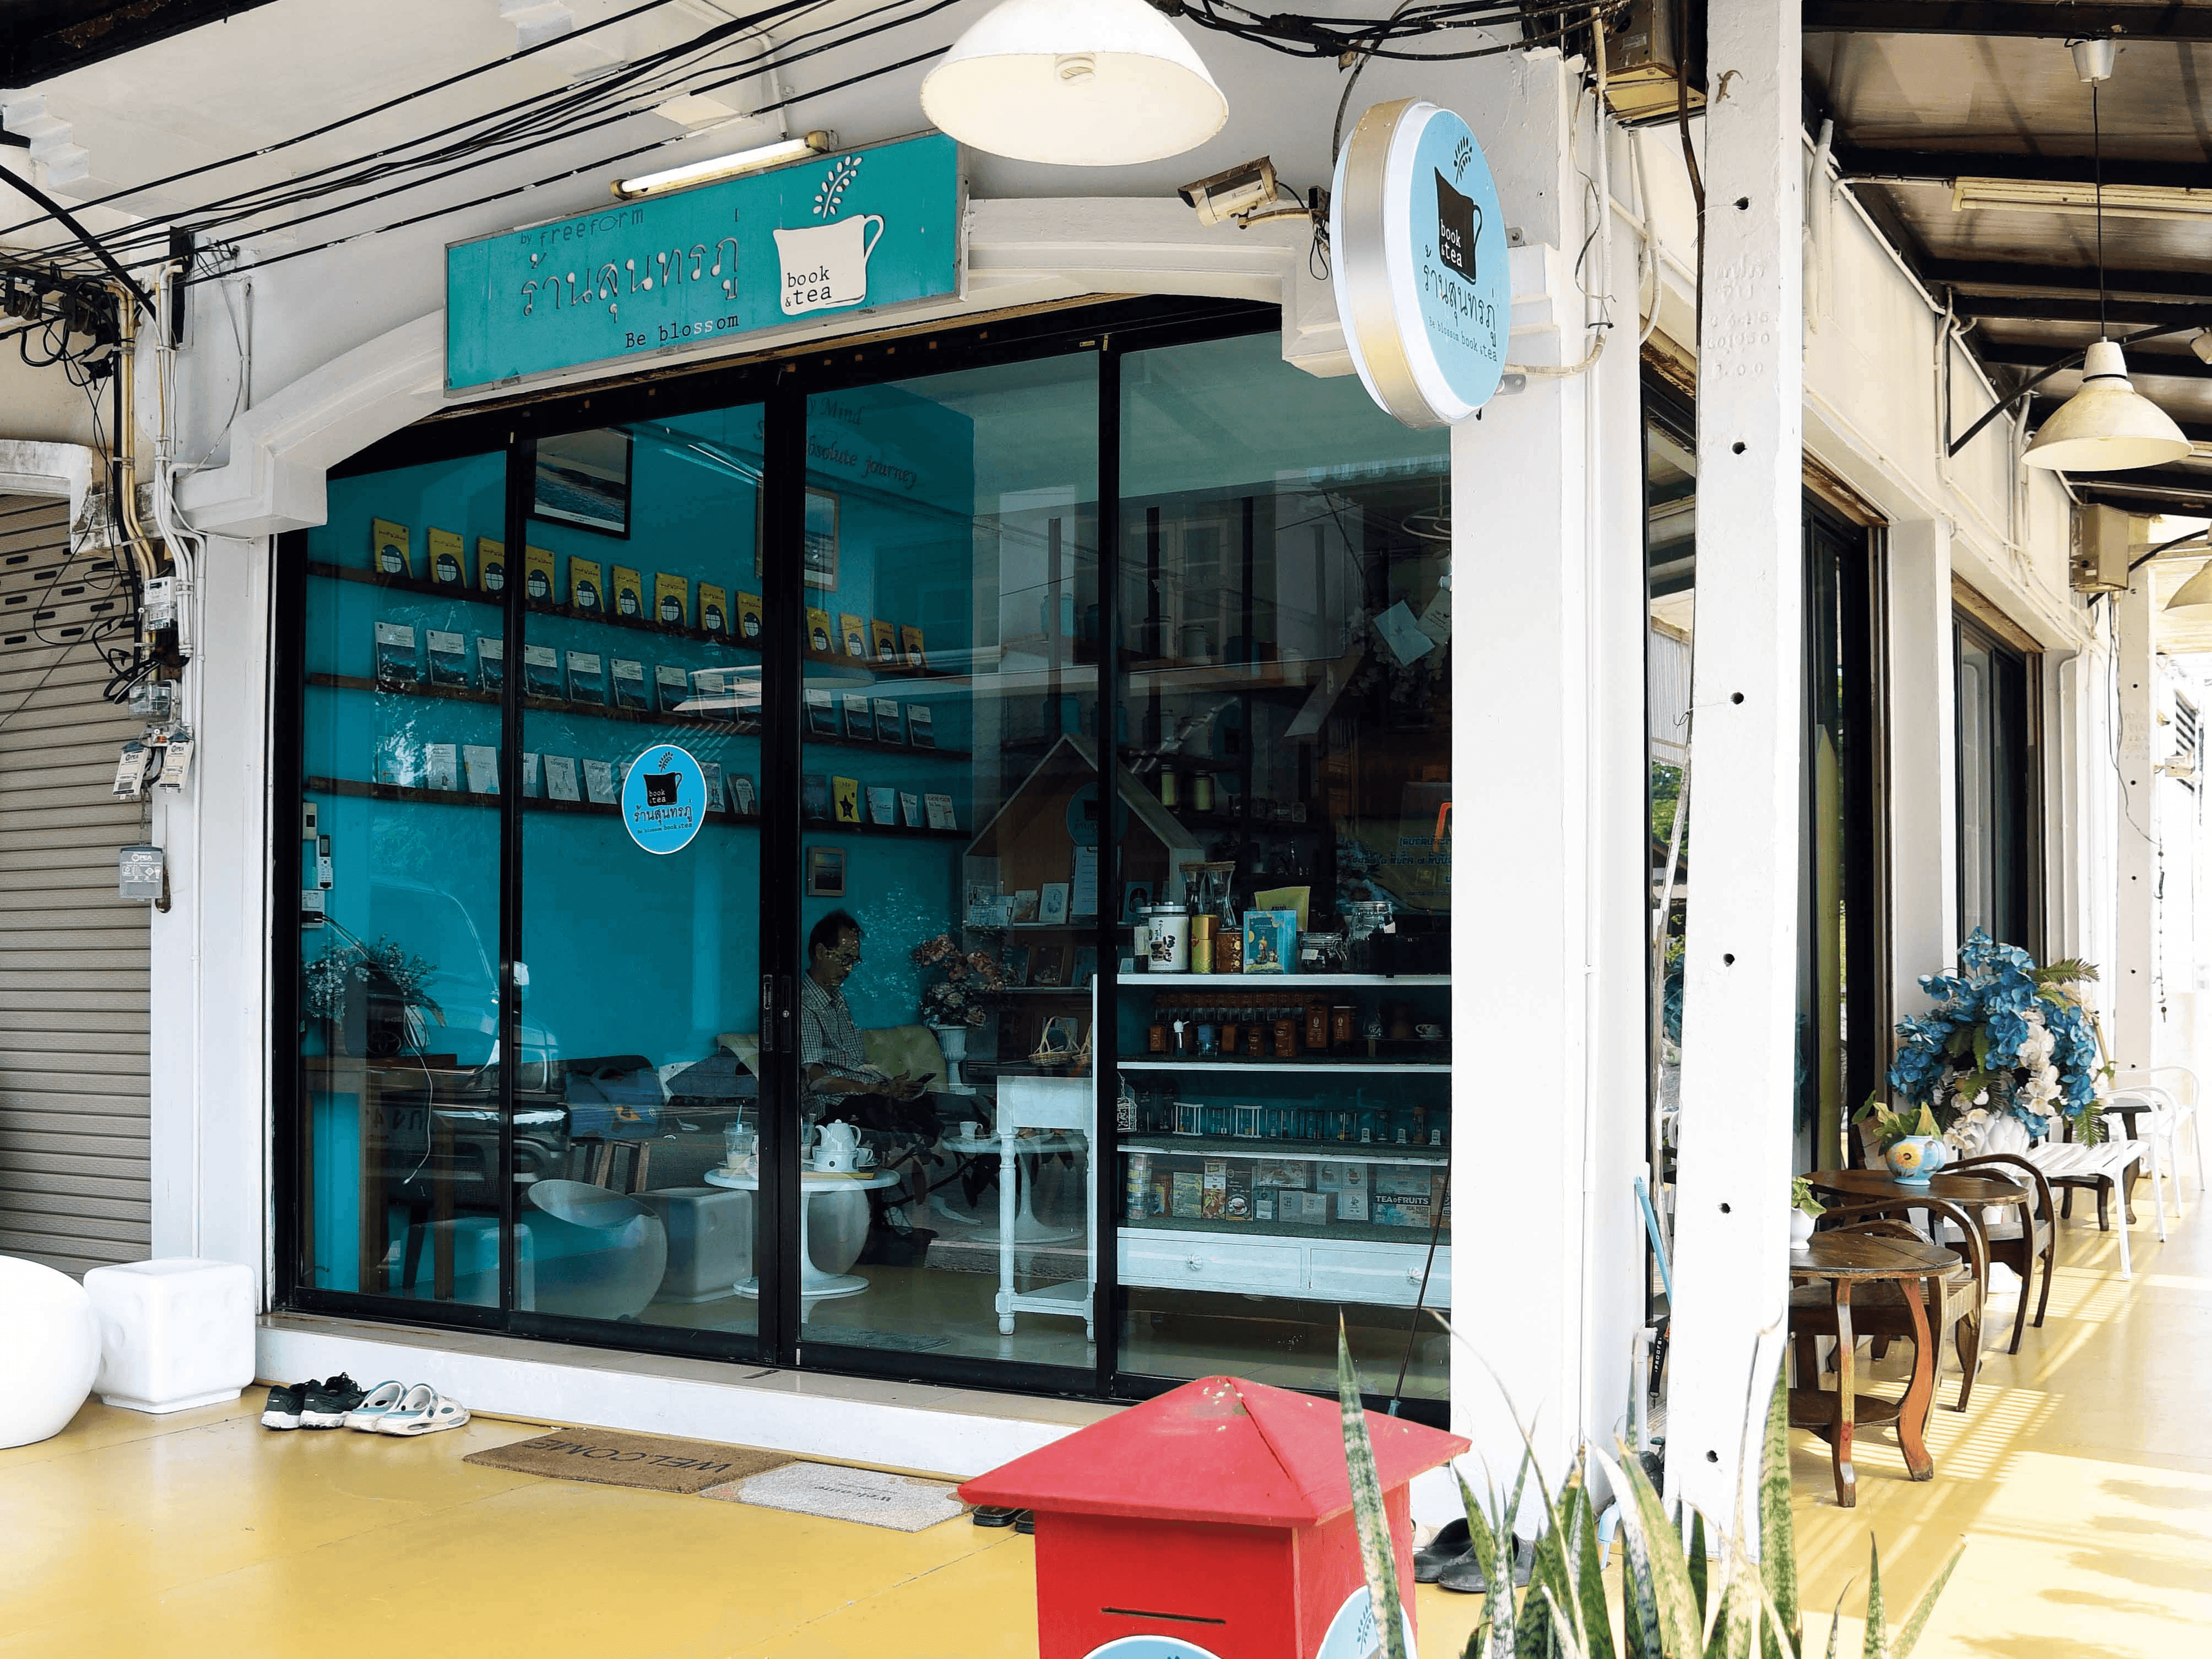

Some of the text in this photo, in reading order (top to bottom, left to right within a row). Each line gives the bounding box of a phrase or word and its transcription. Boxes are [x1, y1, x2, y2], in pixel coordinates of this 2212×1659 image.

[520, 207, 643, 246] by freeform
[1440, 219, 1461, 248] book
[787, 265, 830, 288] book
[1423, 245, 1497, 348] ร้านสุนทรภู่
[625, 313, 739, 349] Be blossom
[1461, 331, 1478, 353] book
[649, 789, 665, 797] book
[634, 798, 692, 825] ร้านสุนทรภู่
[522, 1439, 733, 1473] WELCOME
